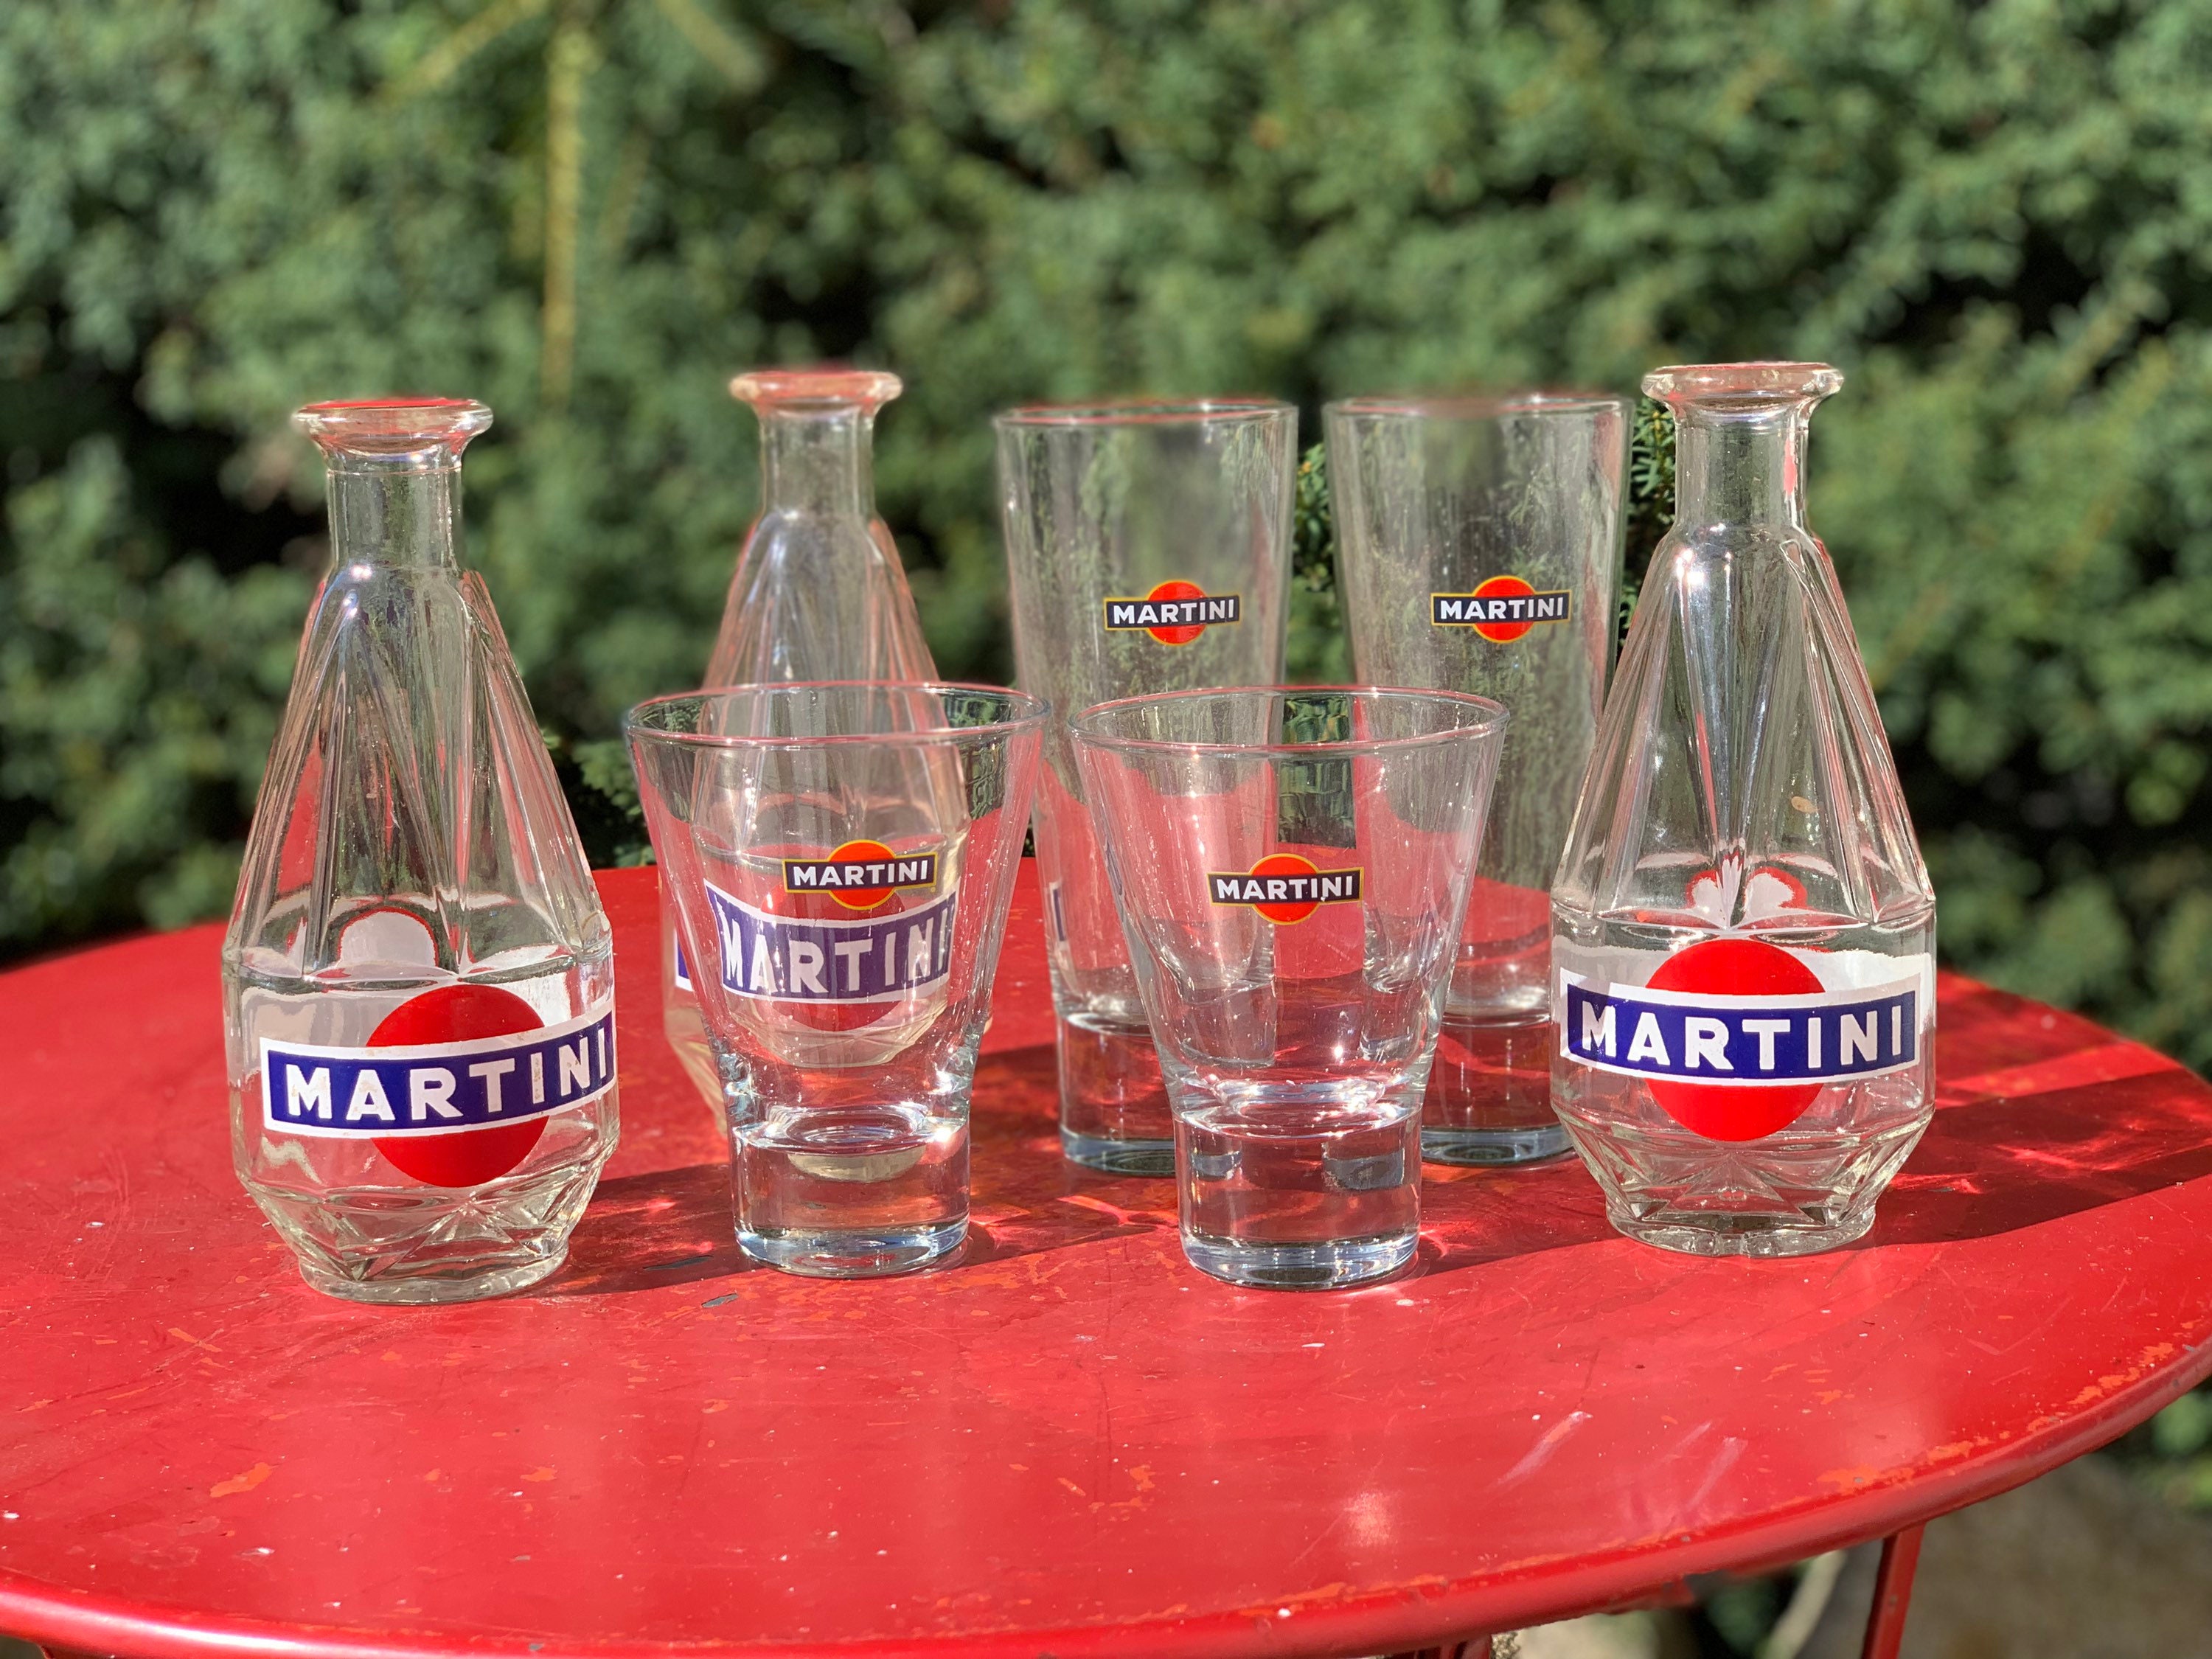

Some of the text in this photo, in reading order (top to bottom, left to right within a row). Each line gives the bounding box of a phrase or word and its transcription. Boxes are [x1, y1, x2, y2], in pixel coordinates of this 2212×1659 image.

[1113, 599, 1234, 625] MARTINI
[1441, 597, 1564, 620] MARTINI
[793, 860, 928, 886] MARTINI
[1217, 875, 1353, 900] MARTINI
[720, 908, 950, 994] MARTINI
[1582, 1001, 1902, 1071] MARTINI
[285, 1028, 606, 1121] MARTINI
